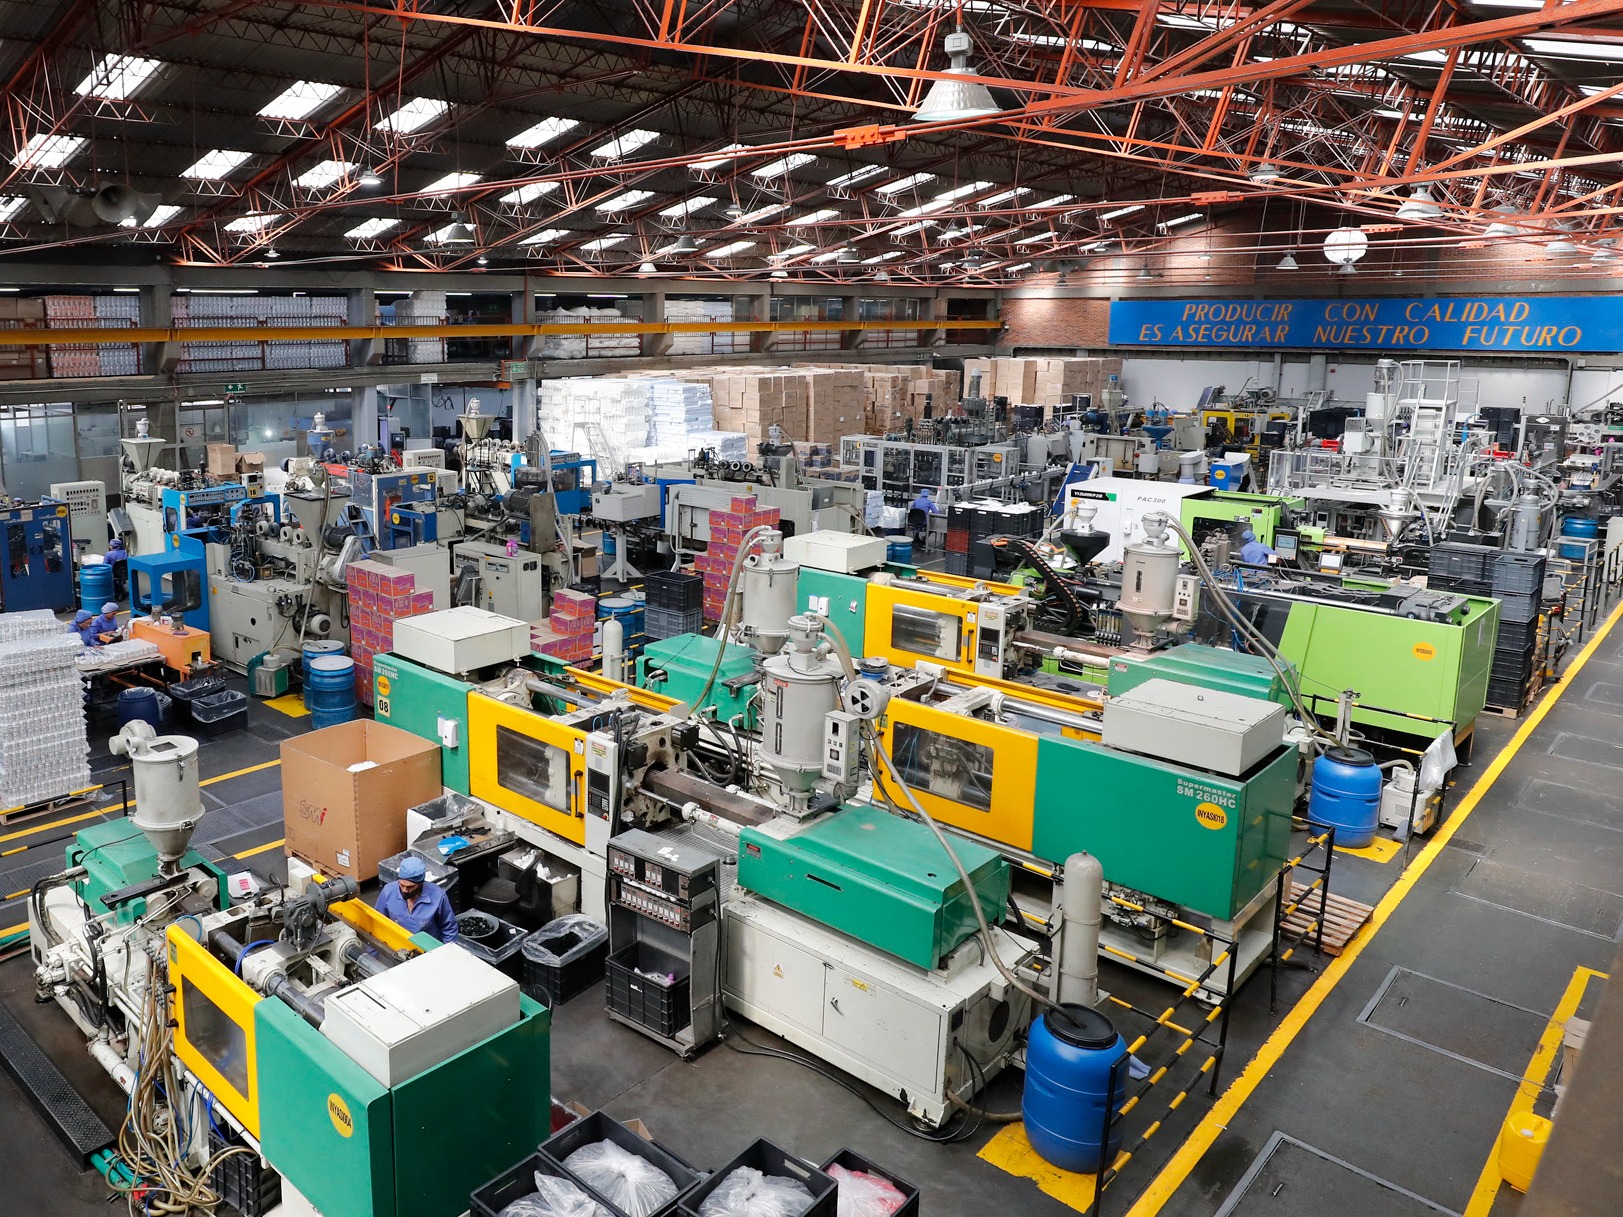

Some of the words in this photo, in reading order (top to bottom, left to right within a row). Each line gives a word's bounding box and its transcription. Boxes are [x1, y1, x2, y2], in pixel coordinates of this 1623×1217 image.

[1182, 303, 1293, 321] PRODUCIR
[1325, 303, 1379, 322] CON
[1405, 302, 1530, 322] CALIDAD
[1138, 324, 1164, 341] ES
[1169, 324, 1289, 343] ASEGURAR
[1313, 325, 1430, 344] NUESTRO
[1462, 325, 1582, 347] FUTURO
[378, 699, 389, 713] 08
[1176, 785, 1194, 798] SM
[1195, 790, 1236, 809] 260HC
[1177, 778, 1237, 798] Supermaster
[1197, 809, 1225, 824] INYASI018
